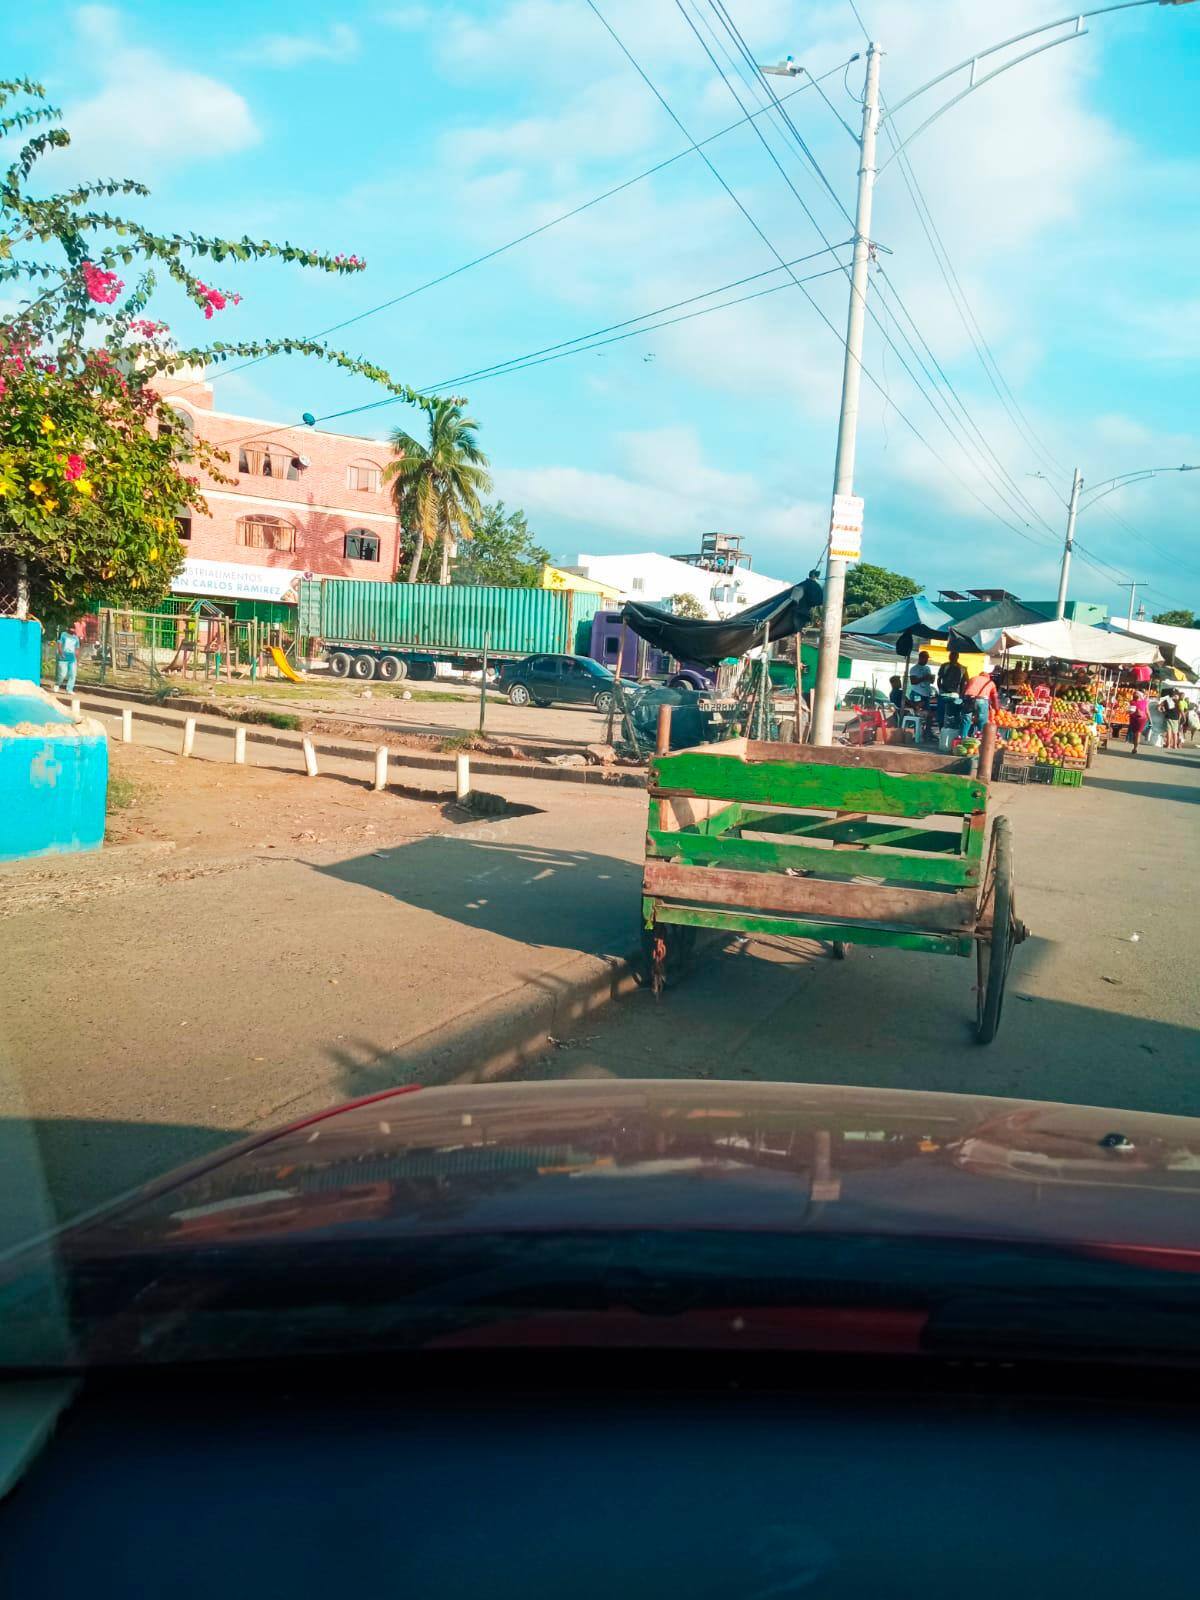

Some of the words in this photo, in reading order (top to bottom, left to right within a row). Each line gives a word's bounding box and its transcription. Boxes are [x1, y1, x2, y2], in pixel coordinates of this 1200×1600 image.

[184, 566, 263, 583] ISTRIALIMENTOS
[192, 578, 233, 591] CARLOS
[237, 583, 281, 595] RAMIREZ
